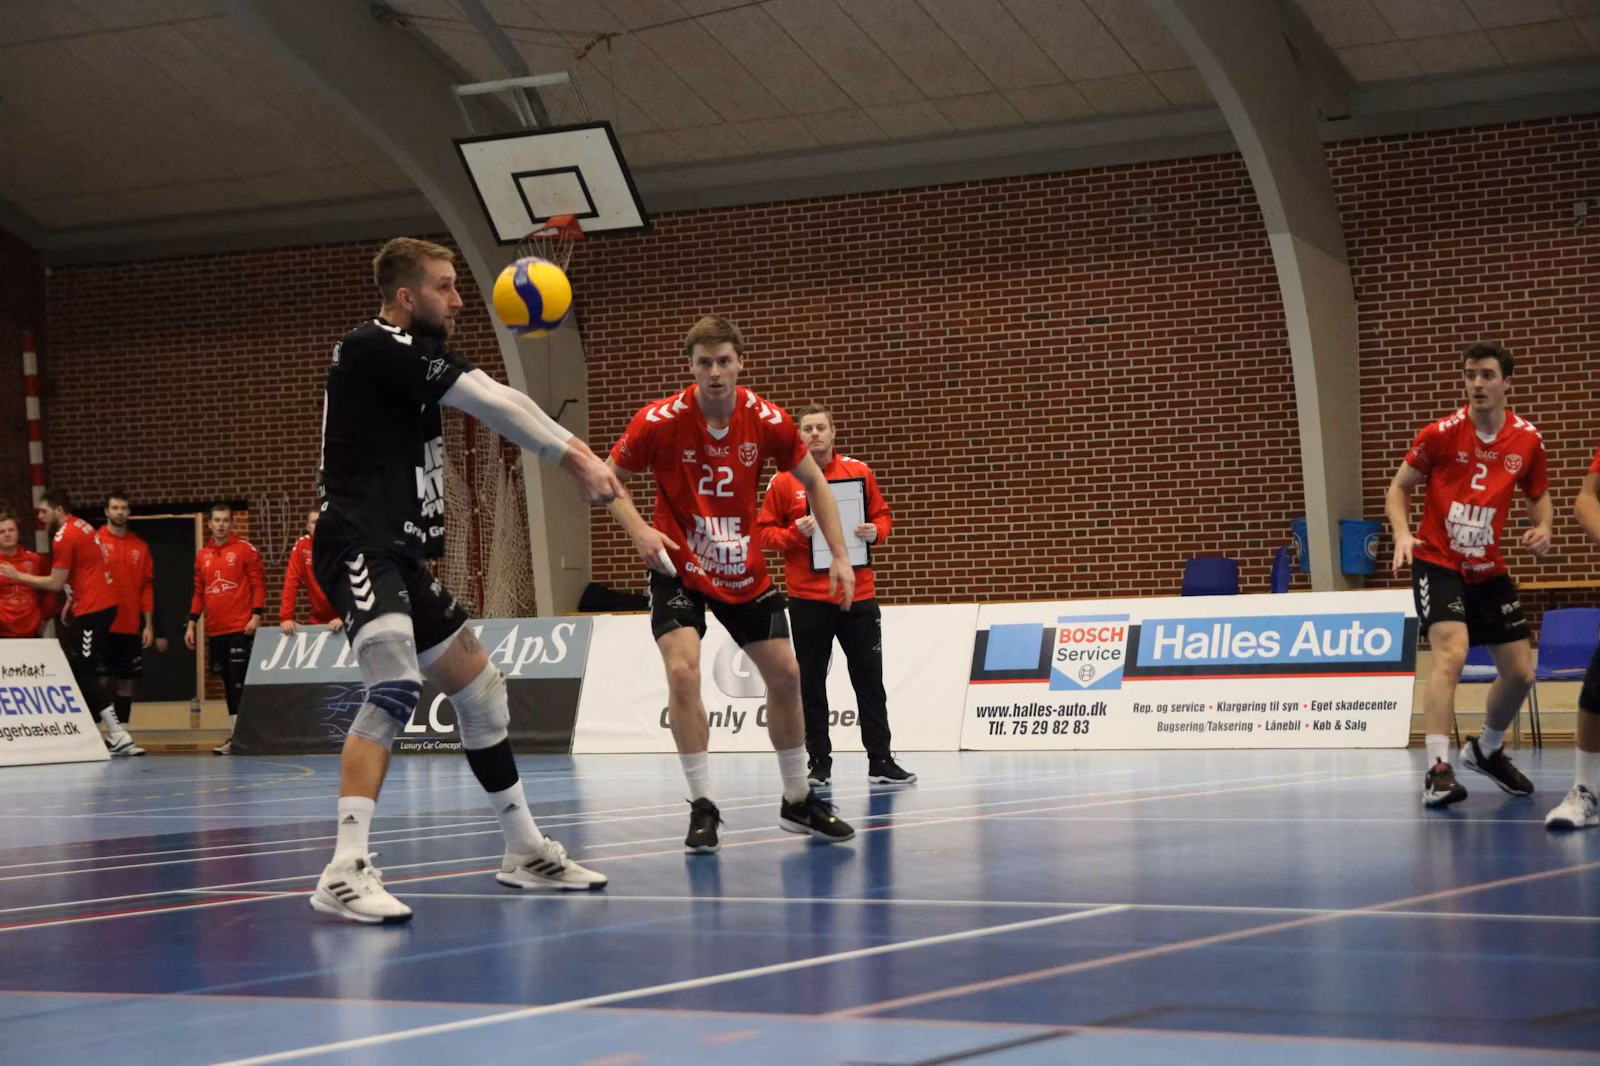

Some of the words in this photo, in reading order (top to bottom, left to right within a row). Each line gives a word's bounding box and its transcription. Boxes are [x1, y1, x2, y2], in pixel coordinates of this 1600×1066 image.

[698, 464, 734, 497] 22
[1471, 462, 1488, 491] 2
[1059, 626, 1124, 643] BOSCH
[1152, 622, 1281, 661] Halles
[1289, 619, 1393, 657] Auto
[260, 631, 334, 671] JM
[488, 622, 576, 676] ApS
[1056, 645, 1121, 662] Service
[0, 685, 82, 716] ERVICE
[1133, 702, 1154, 714] Rep.
[1156, 704, 1168, 714] og
[1170, 701, 1205, 713] service
[1217, 701, 1267, 713] Klargøring
[1269, 700, 1280, 711] til
[1282, 702, 1299, 713] syn
[1311, 700, 1333, 712] Eget
[1335, 700, 1397, 711] skadecenter
[976, 701, 1107, 718] www.halles-auto.dk
[989, 720, 1007, 735] Tlf.
[1012, 720, 1028, 735] 75
[1031, 720, 1048, 735] 29
[1052, 720, 1069, 735] 82
[1073, 719, 1090, 735] 83
[1157, 720, 1253, 733] Bugsering/Taksering
[1265, 719, 1301, 731] Lånebil
[1313, 719, 1332, 730] Køb
[1334, 720, 1341, 730] &
[1345, 719, 1367, 732] Salg
[400, 741, 422, 751] Luxury
[422, 741, 434, 750] Car
[434, 741, 461, 751] Concept
